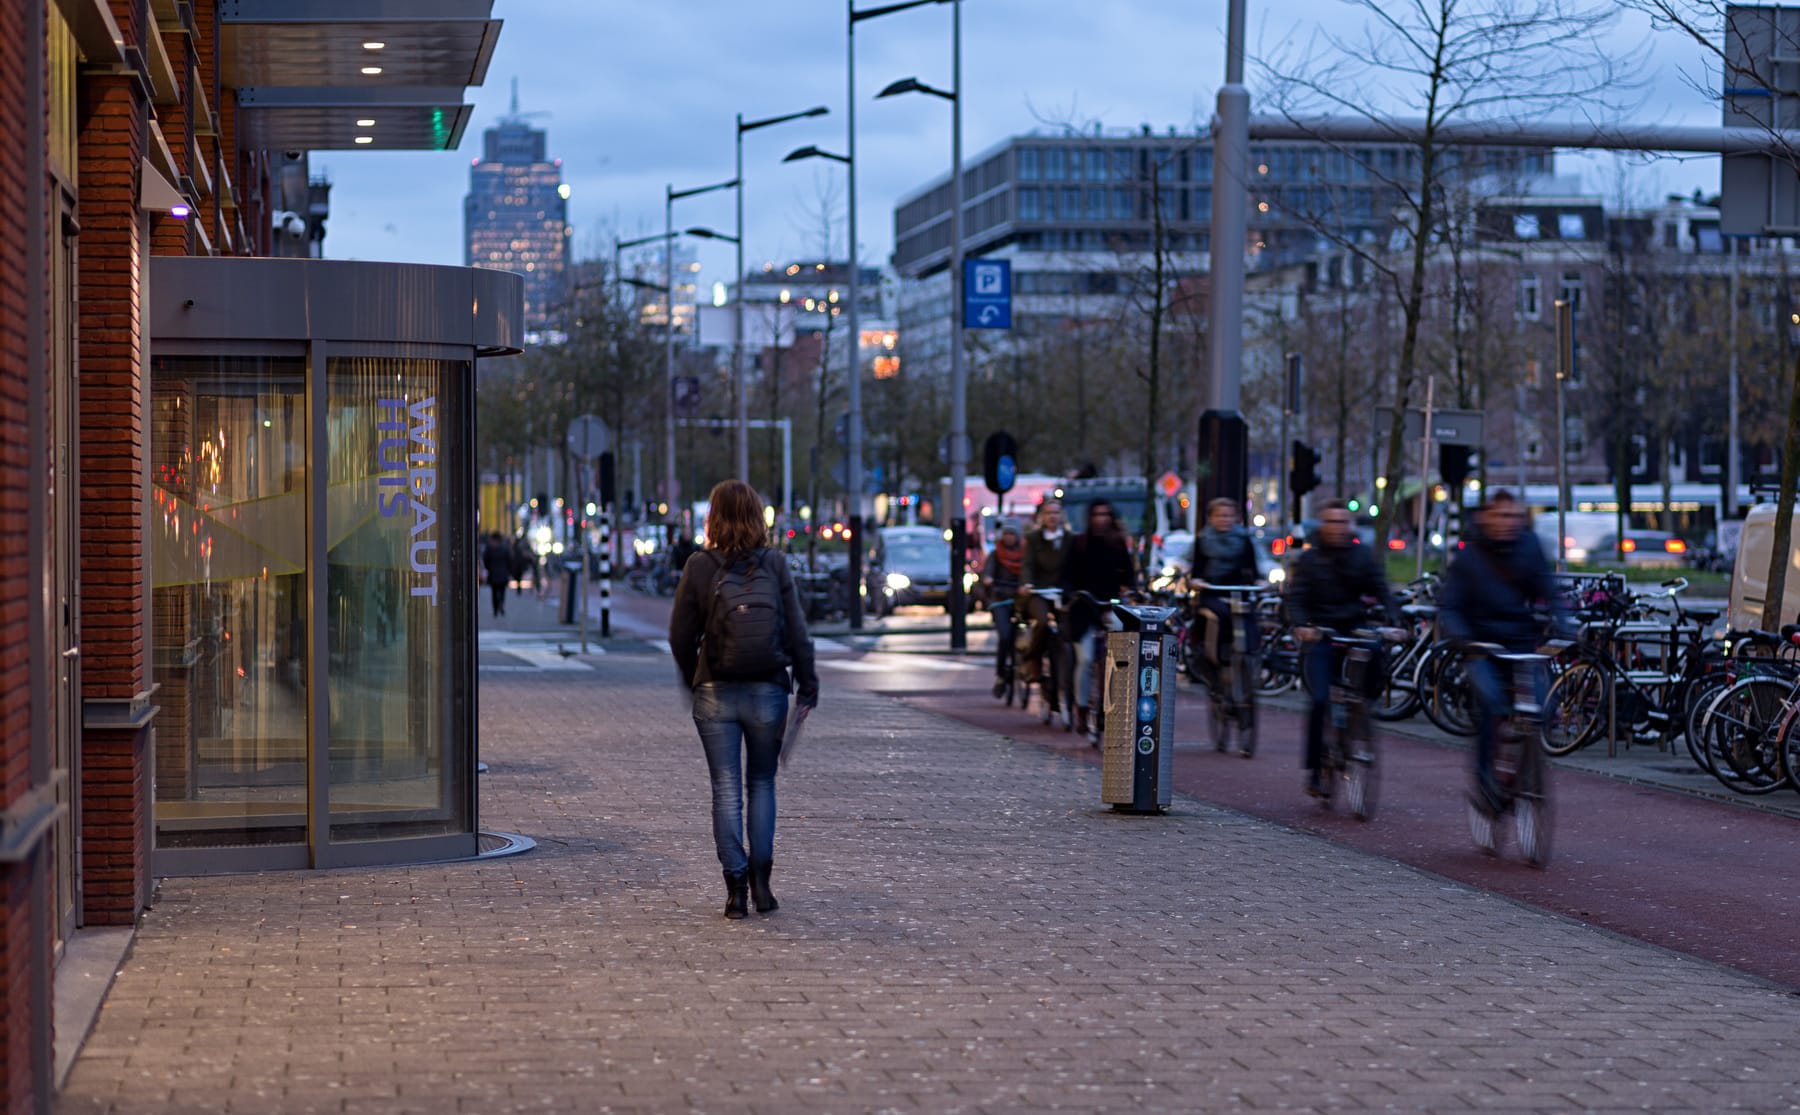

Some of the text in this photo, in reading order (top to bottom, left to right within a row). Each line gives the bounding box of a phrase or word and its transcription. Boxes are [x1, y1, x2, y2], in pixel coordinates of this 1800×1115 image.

[982, 273, 996, 288] P
[378, 399, 408, 518] HUIS
[410, 397, 438, 606] WIBAUT
